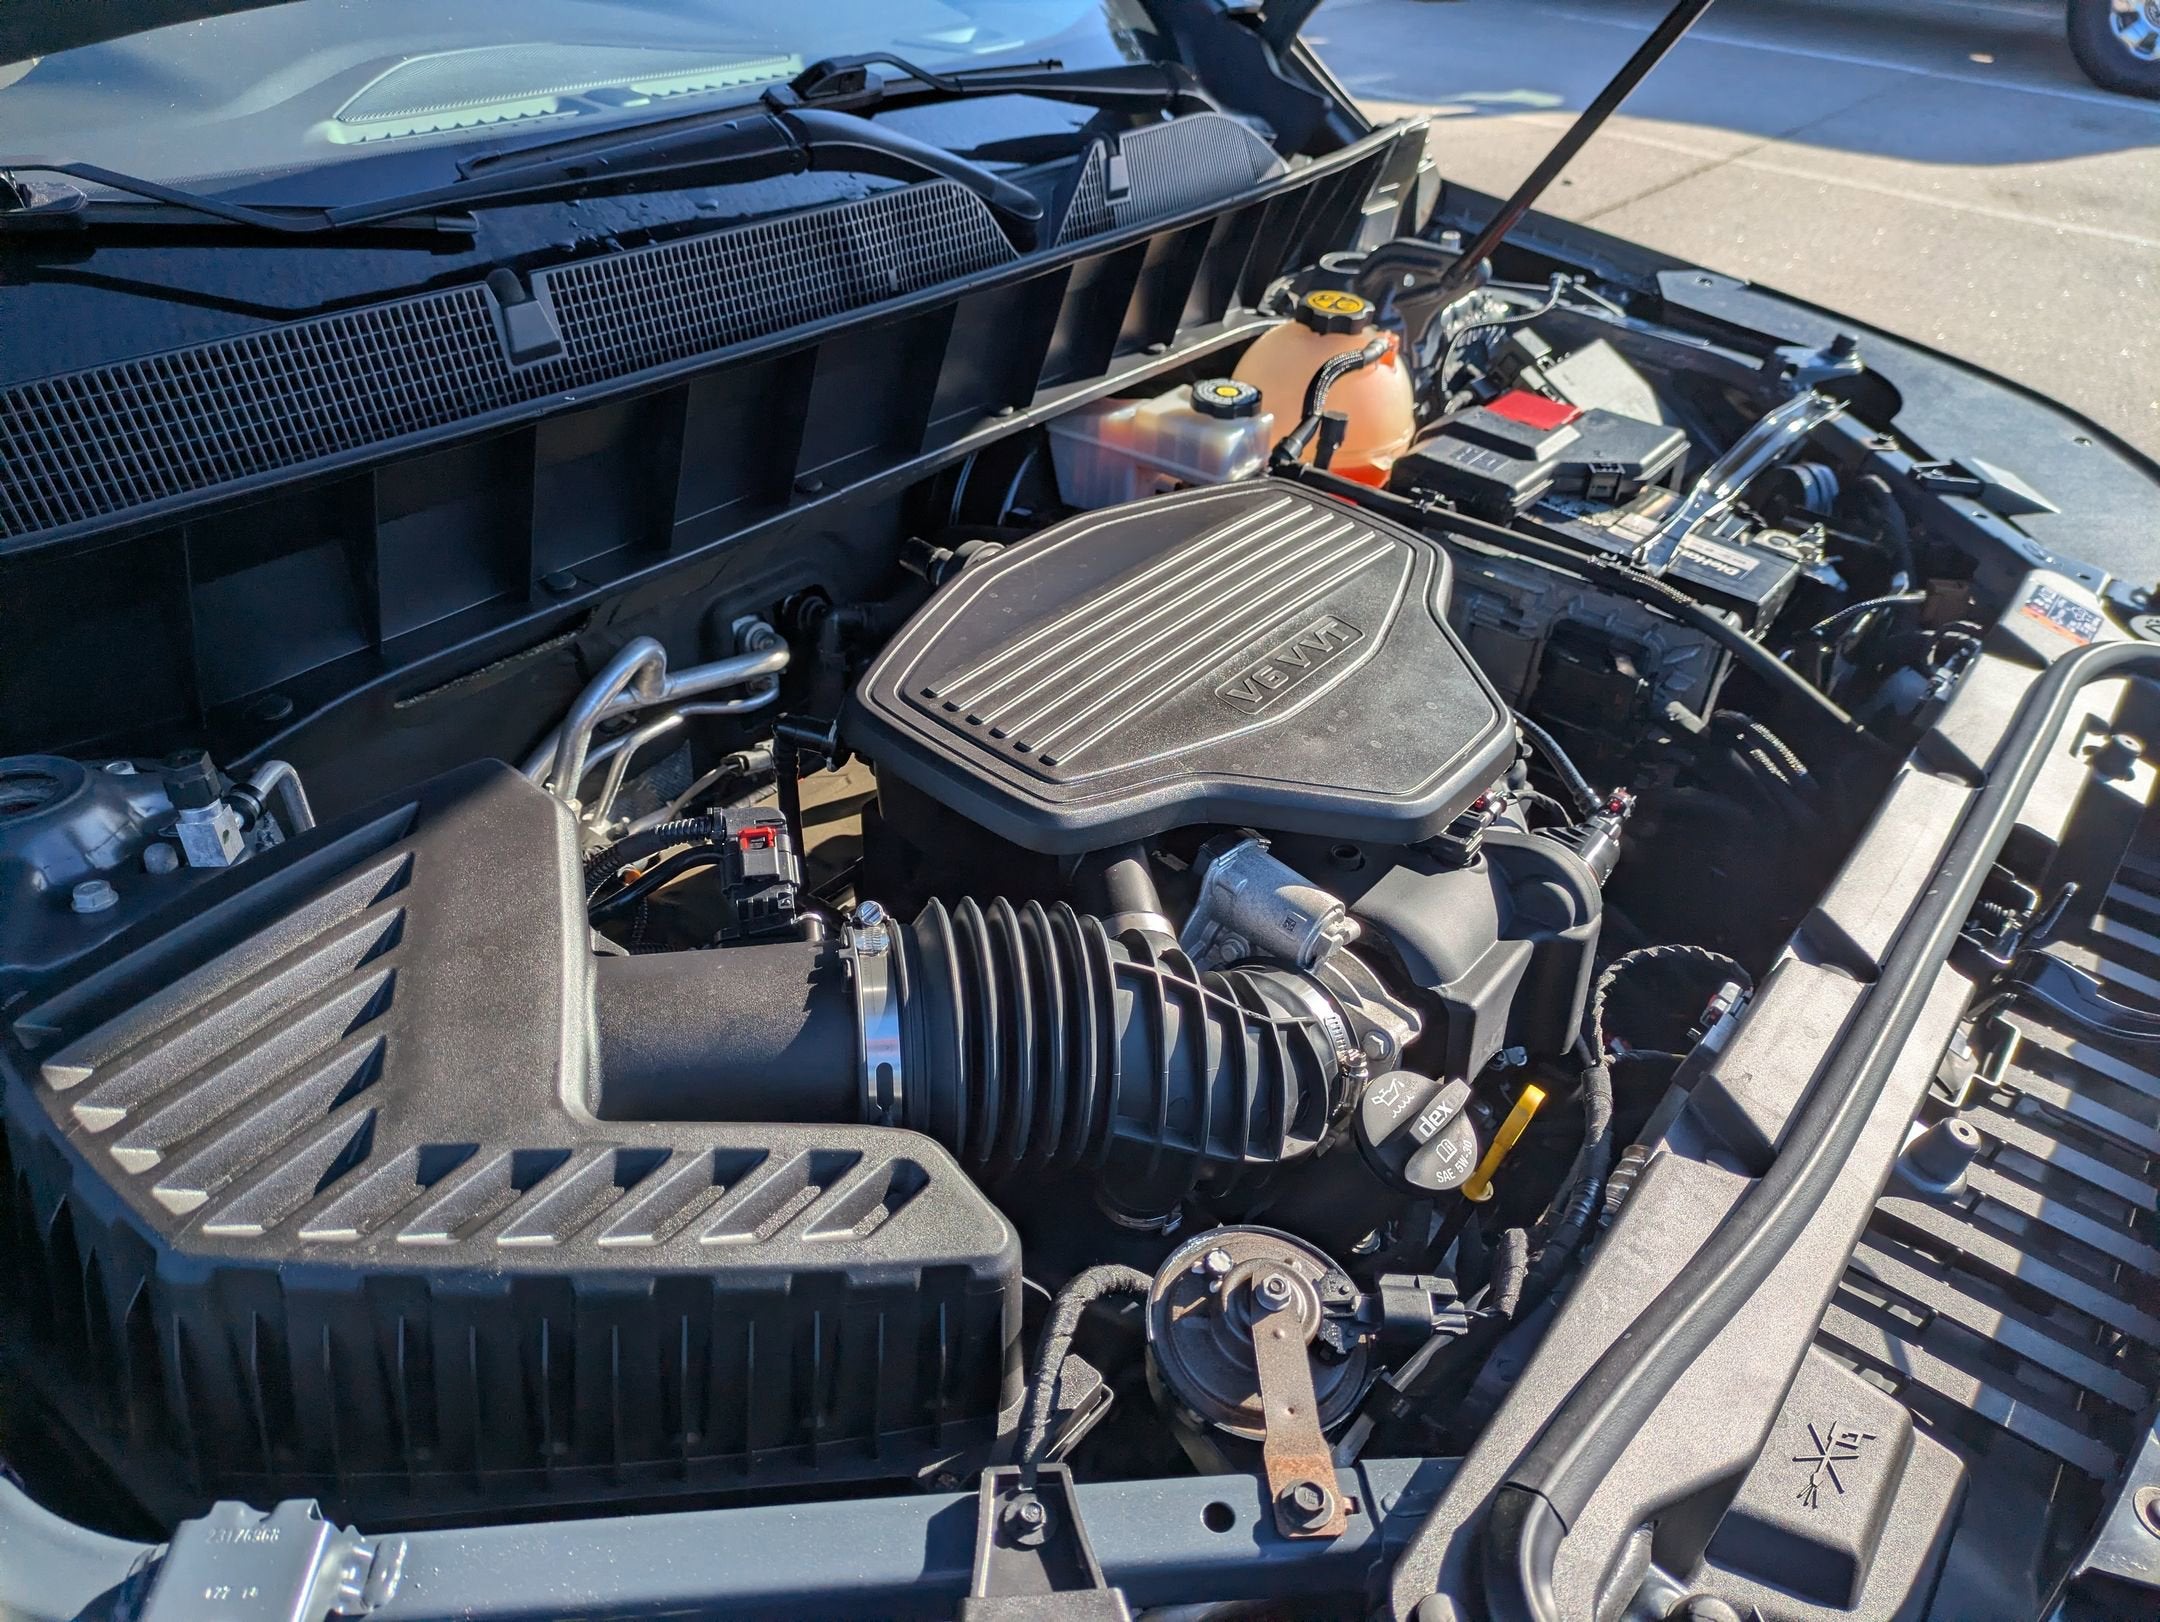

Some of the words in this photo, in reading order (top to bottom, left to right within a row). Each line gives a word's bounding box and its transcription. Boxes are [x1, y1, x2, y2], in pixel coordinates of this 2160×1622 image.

[1225, 664, 1289, 703] V6
[1275, 620, 1349, 669] VVT
[1436, 1167, 1456, 1183] SAE
[1454, 1139, 1473, 1173] 5W-30
